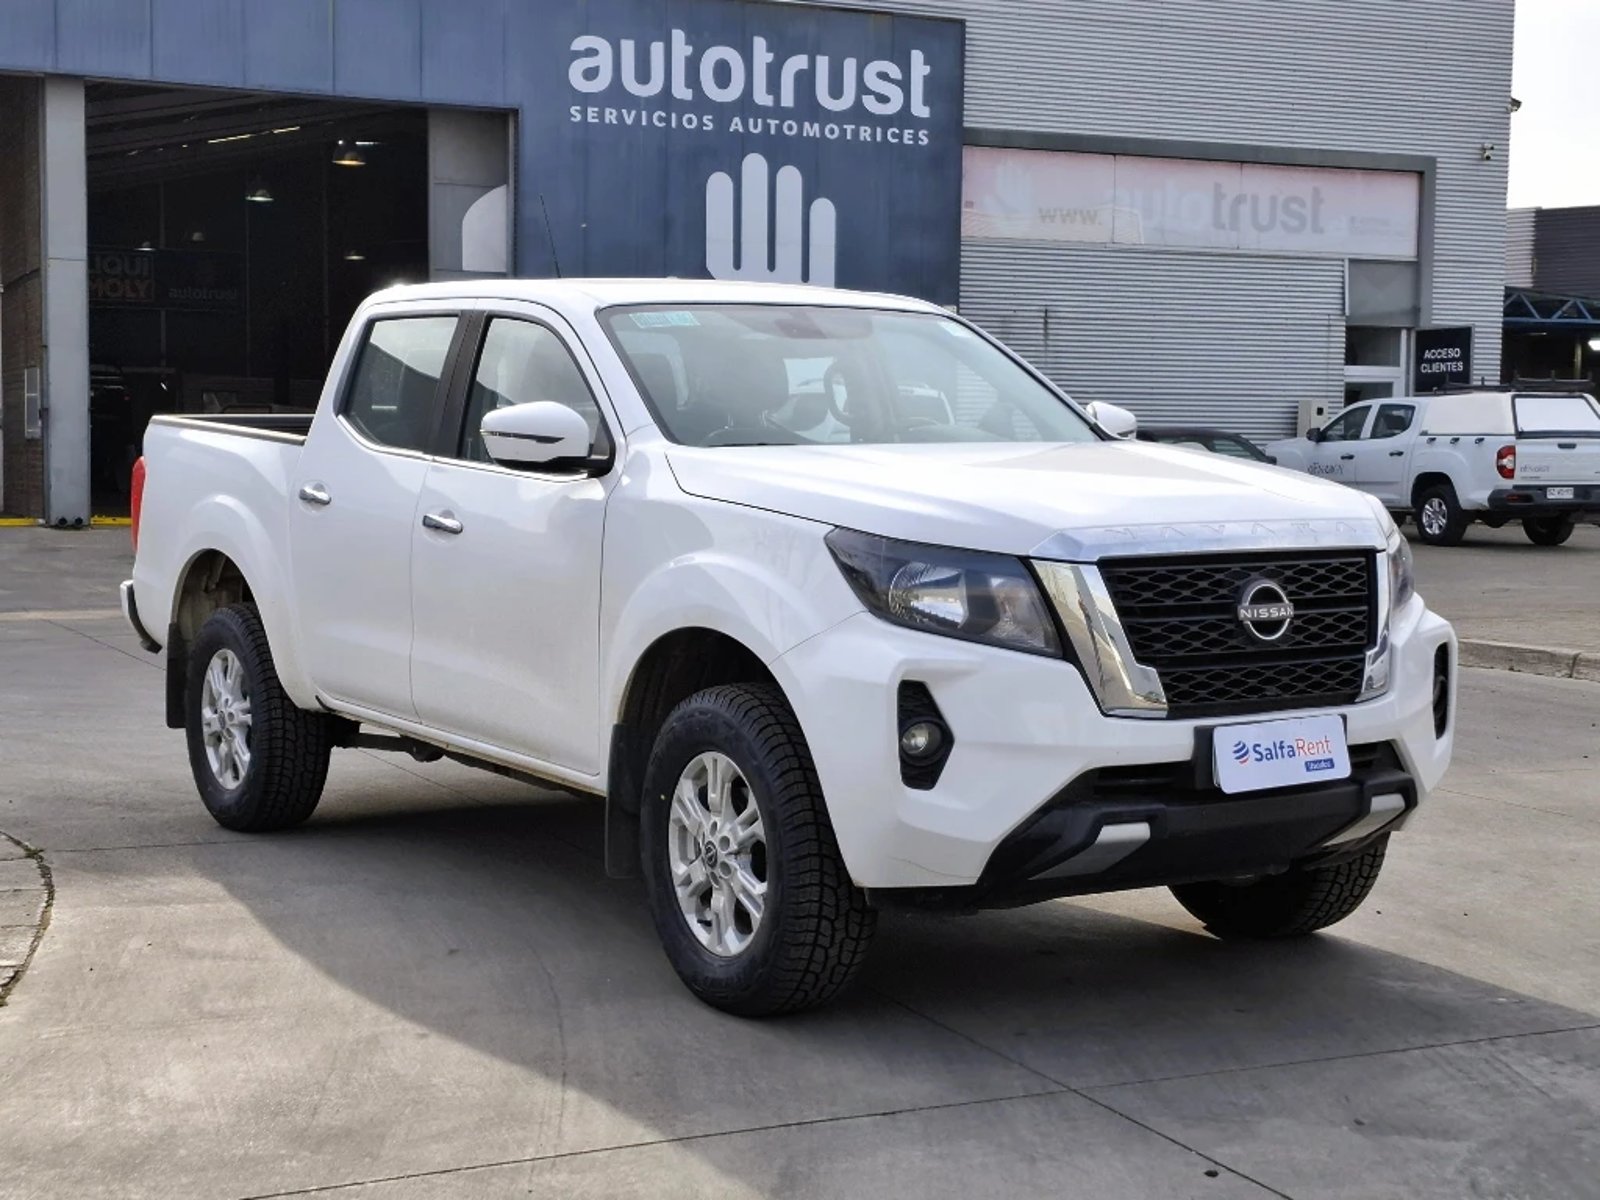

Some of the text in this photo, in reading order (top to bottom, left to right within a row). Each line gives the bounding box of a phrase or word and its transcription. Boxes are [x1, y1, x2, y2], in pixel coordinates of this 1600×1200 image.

[568, 28, 931, 119] autotrust
[569, 105, 930, 146] SERVICIOS AUTOMOTRICES
[89, 255, 149, 276] IQUI
[1424, 347, 1461, 359] ACCESO
[1420, 360, 1464, 373] CLIENTES
[1240, 606, 1293, 618] NISSAN
[1252, 735, 1332, 762] SalfaRent
